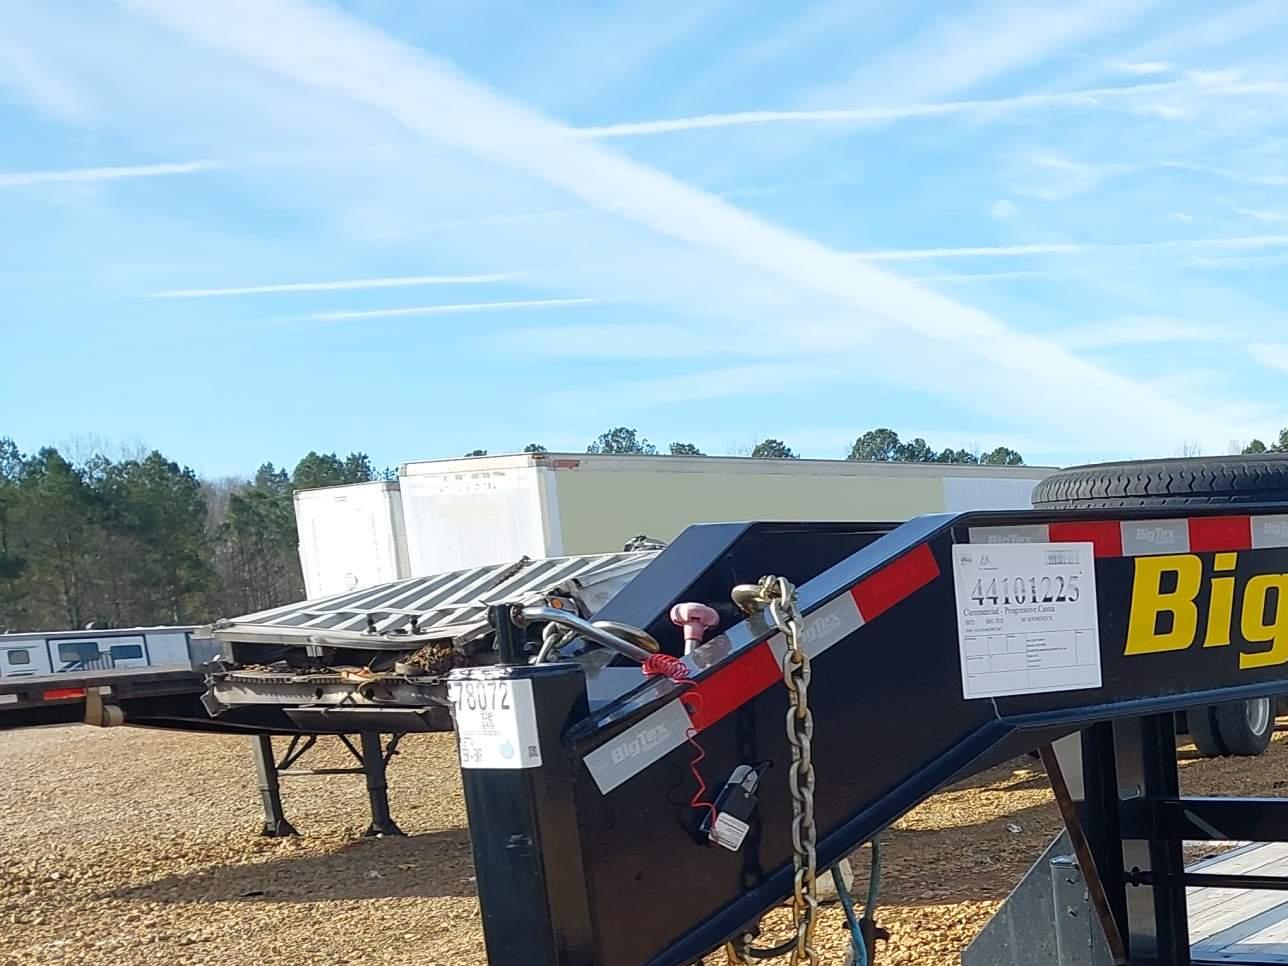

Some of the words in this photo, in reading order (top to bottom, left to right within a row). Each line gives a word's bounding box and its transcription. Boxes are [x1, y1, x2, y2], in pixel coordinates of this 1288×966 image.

[1136, 528, 1175, 543] BigTex
[971, 576, 1080, 606] 44101225
[963, 608, 999, 617] Commercial
[1004, 606, 1037, 616] Progressive
[611, 721, 669, 764] BigTex
